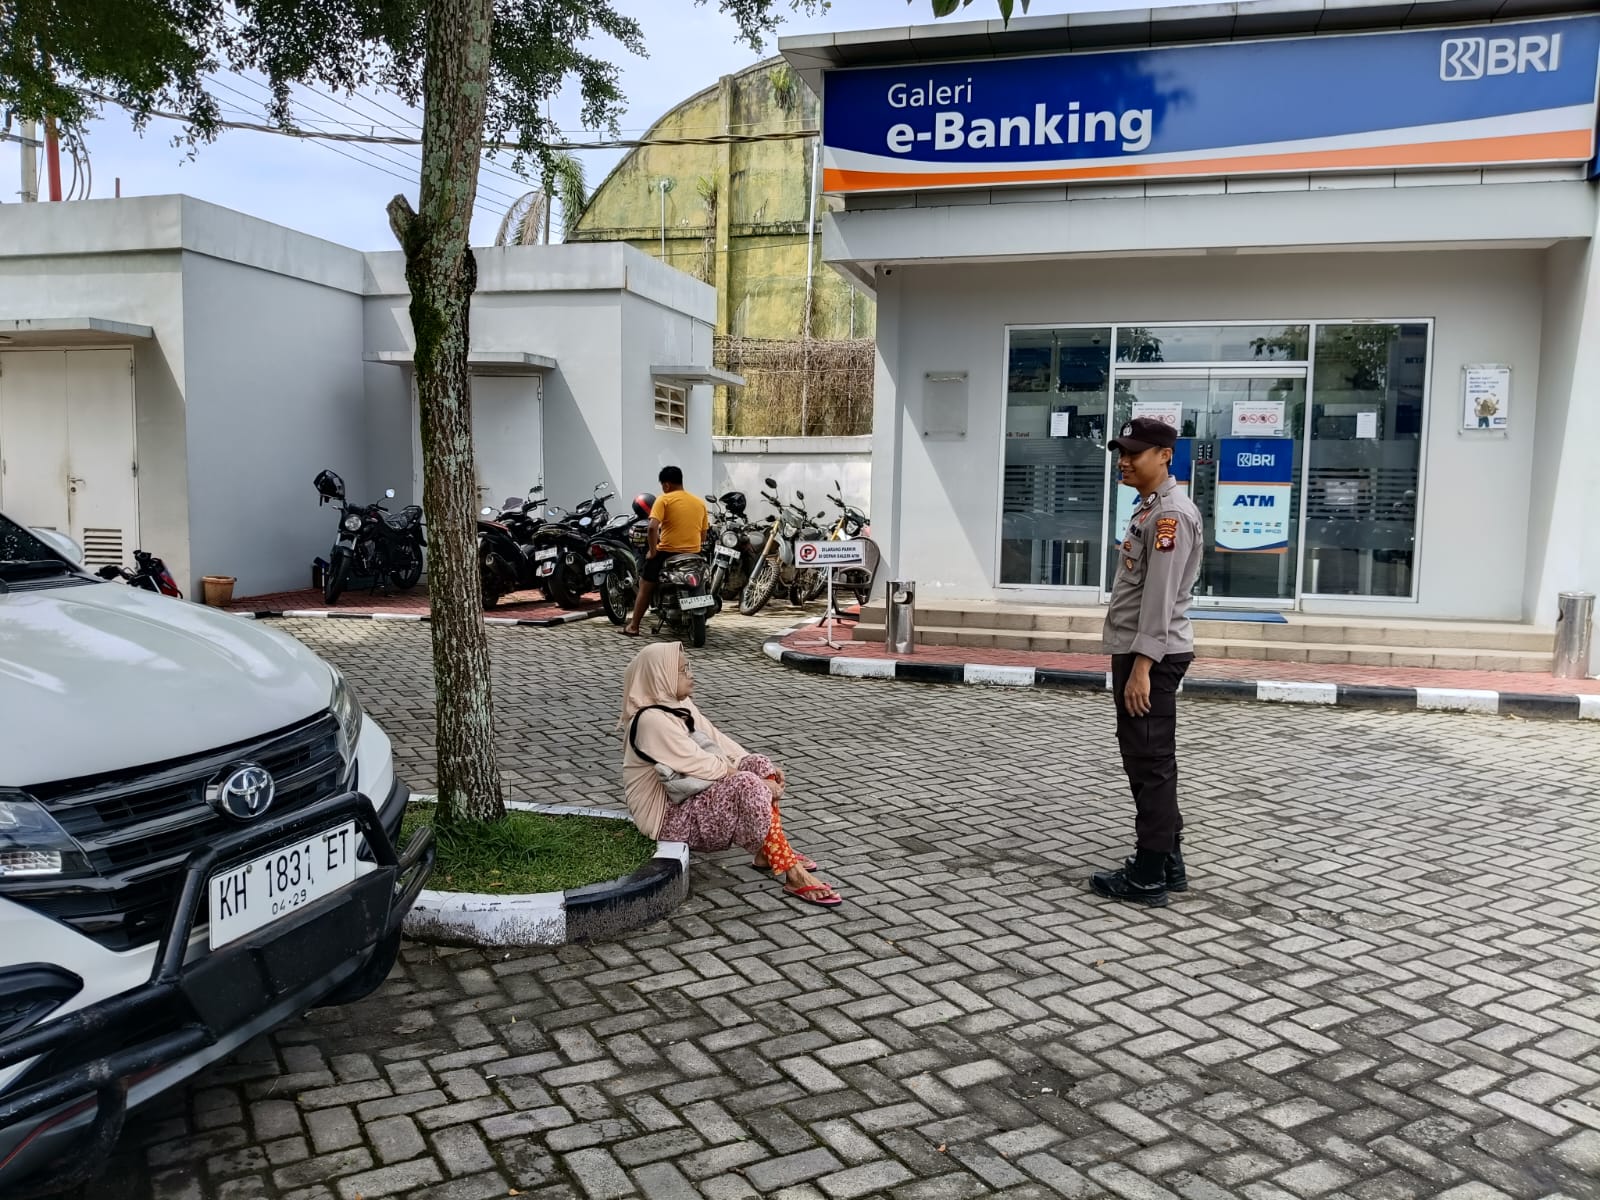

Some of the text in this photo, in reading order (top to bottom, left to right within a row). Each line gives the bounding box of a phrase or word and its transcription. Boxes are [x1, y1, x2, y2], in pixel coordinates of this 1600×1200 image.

[1486, 33, 1561, 76] BRI
[887, 77, 973, 108] Galeri
[886, 101, 1153, 153] e-Banking
[1252, 454, 1275, 467] BRI
[1233, 494, 1275, 508] ATM
[220, 828, 349, 921] KH 1831 ET
